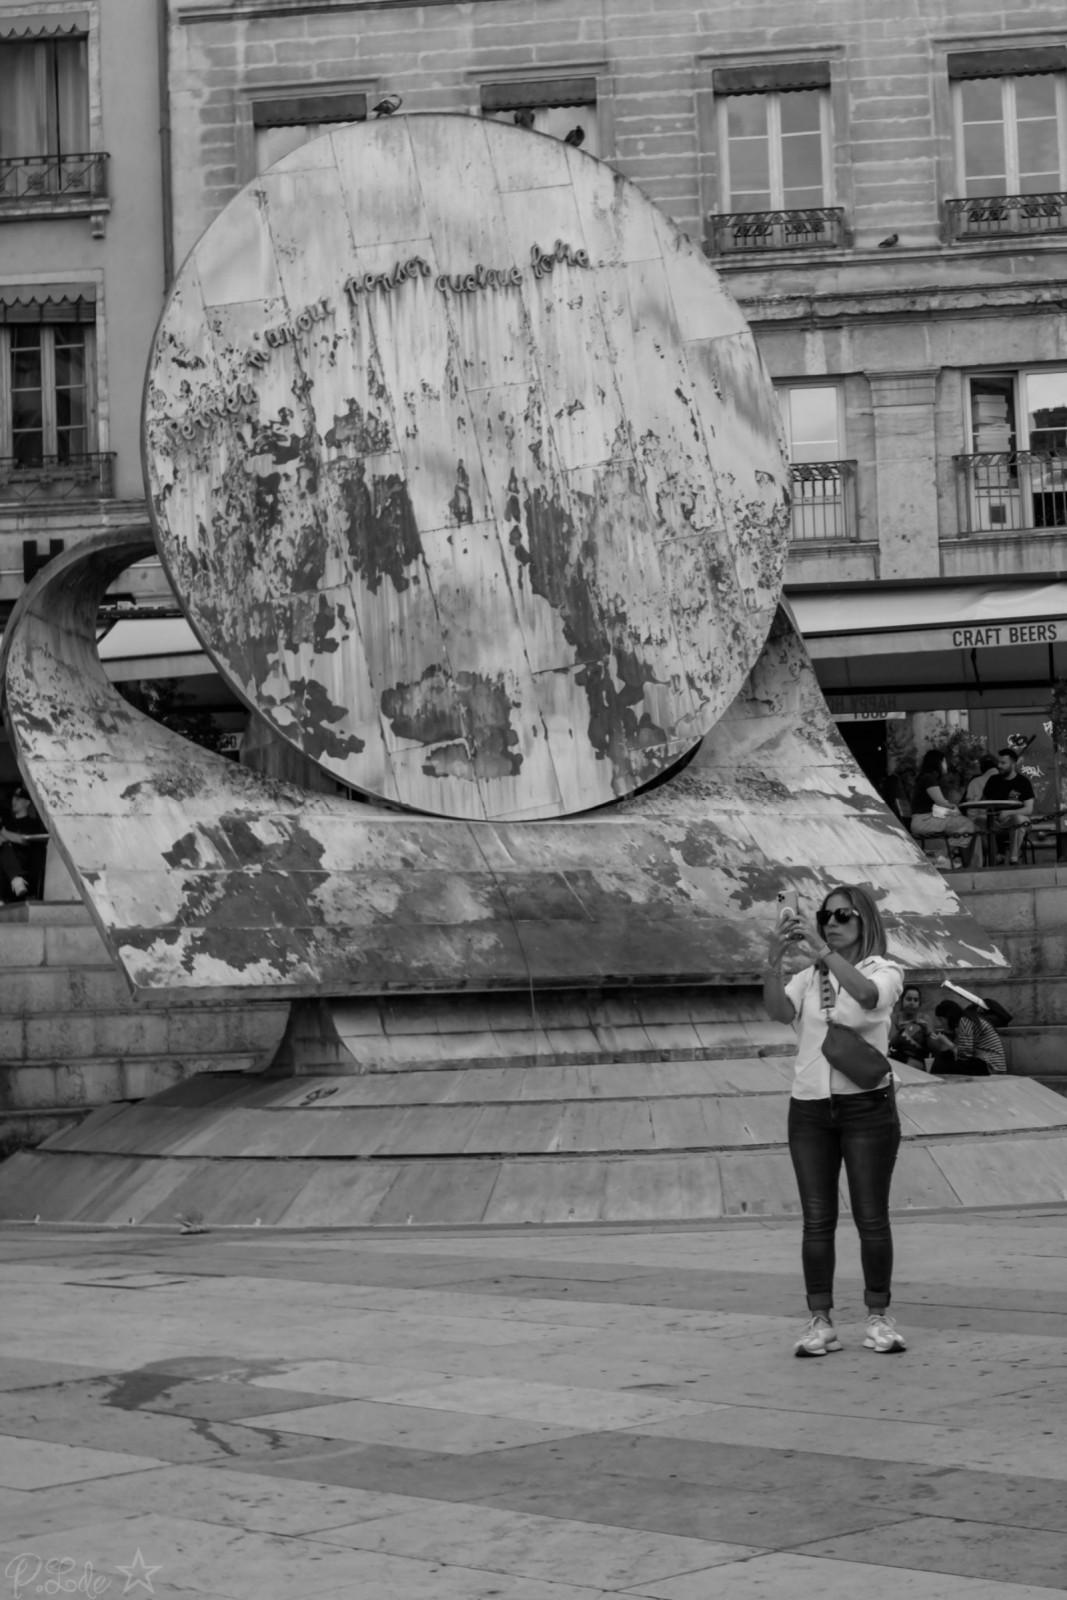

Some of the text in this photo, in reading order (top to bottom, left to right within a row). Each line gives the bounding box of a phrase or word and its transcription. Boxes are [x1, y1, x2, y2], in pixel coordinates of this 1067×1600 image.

[343, 255, 431, 306] penser
[436, 263, 523, 300] quelque
[953, 624, 1057, 647] CRAFT BEERS
